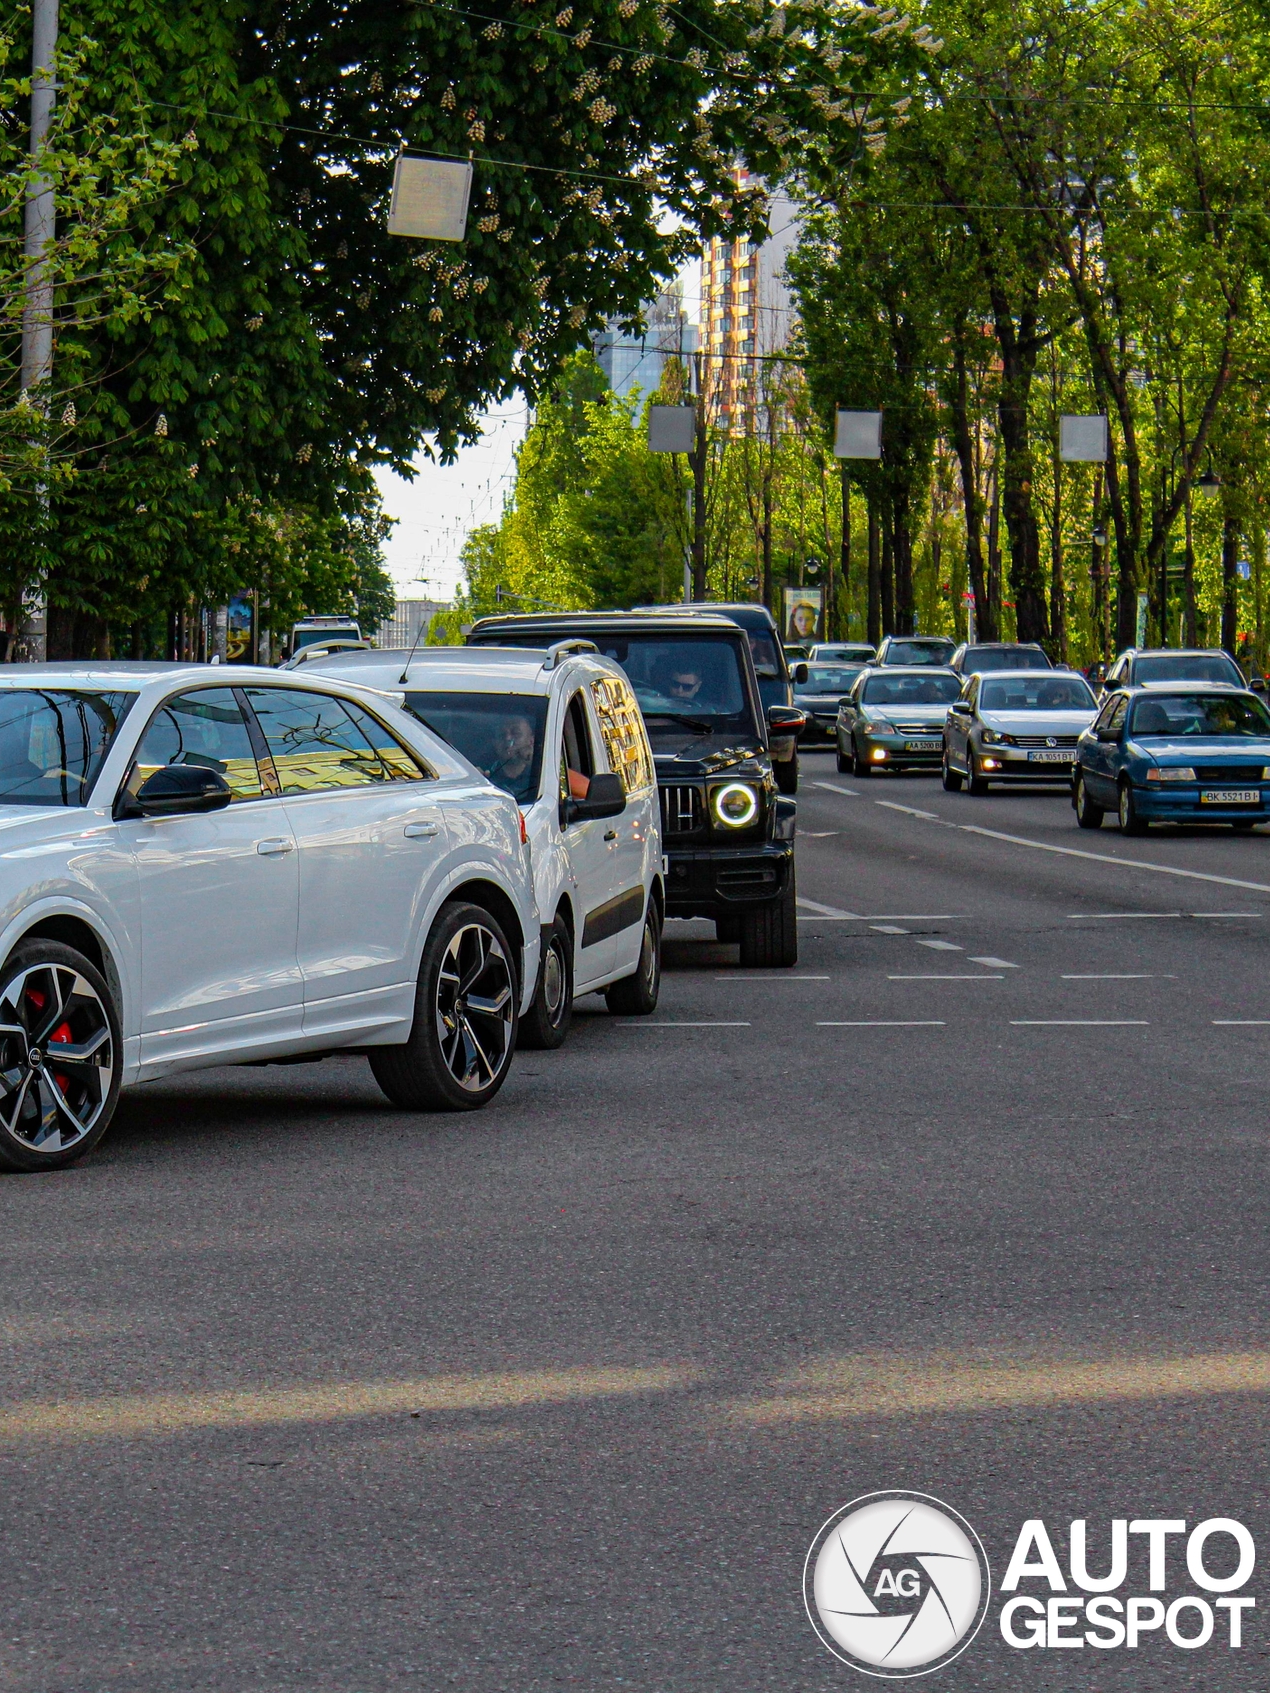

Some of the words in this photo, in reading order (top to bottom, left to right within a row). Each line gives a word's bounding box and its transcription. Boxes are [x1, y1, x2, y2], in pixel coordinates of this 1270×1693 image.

[1032, 753, 1044, 761] KA
[1045, 753, 1060, 761] 1051
[1062, 753, 1073, 761] BT
[1207, 792, 1220, 801] BK
[1222, 792, 1243, 801] 5521
